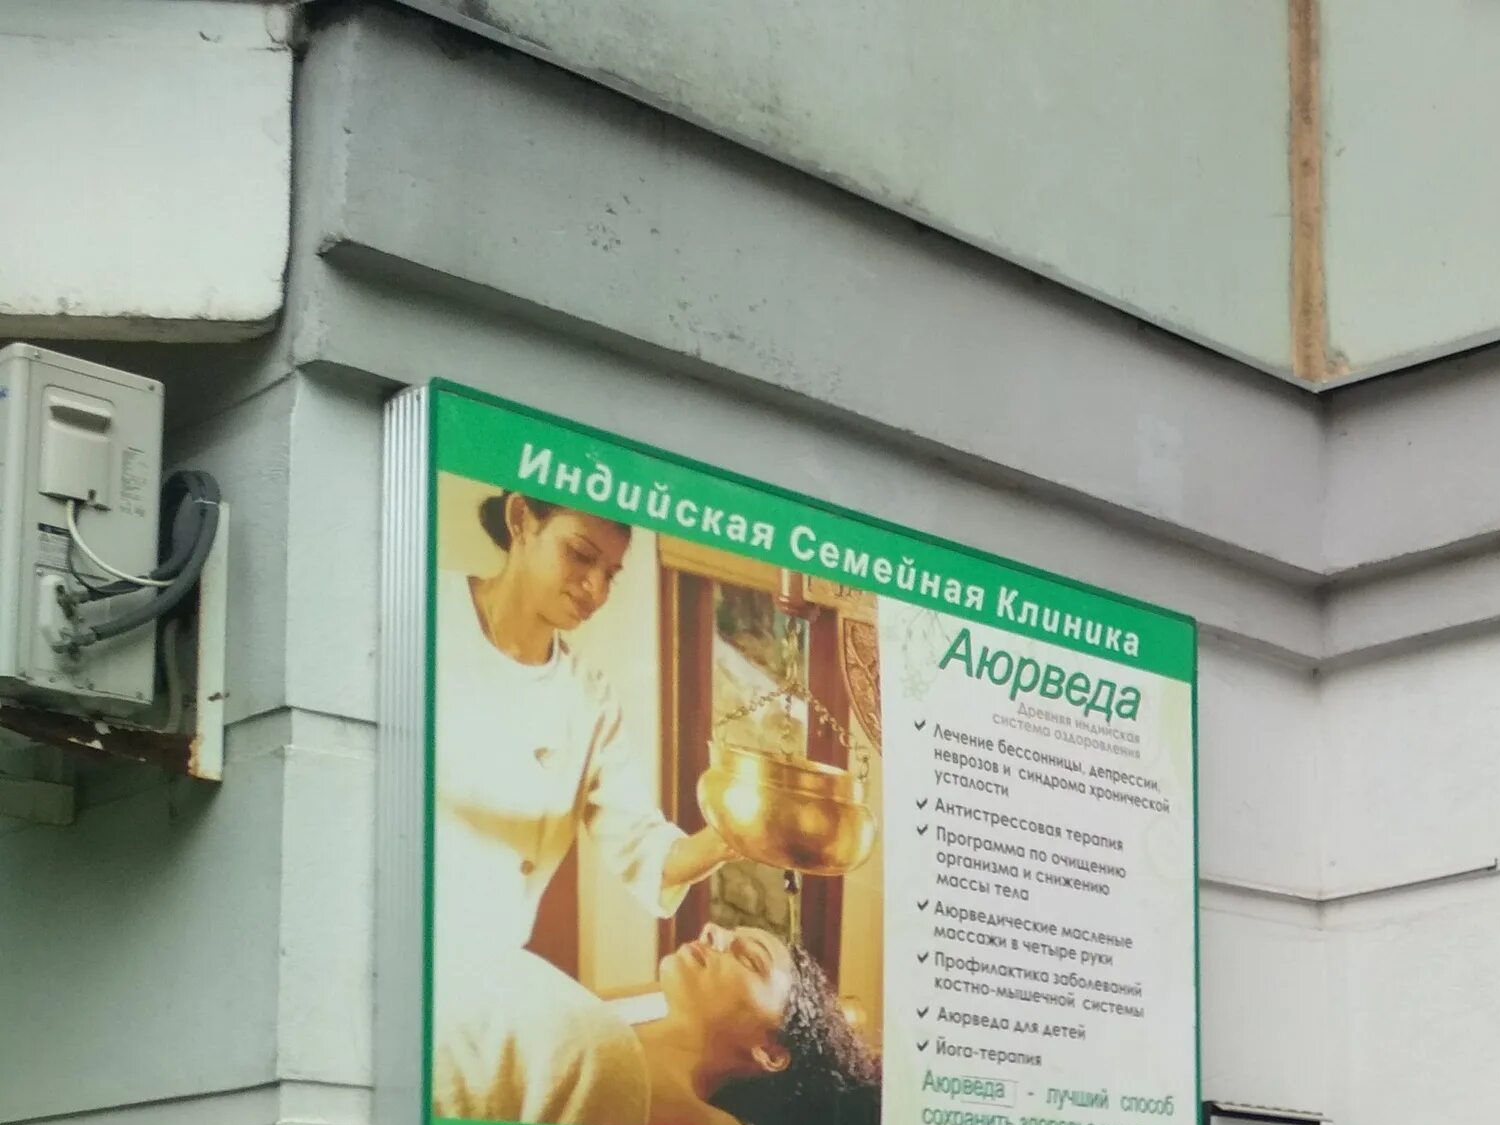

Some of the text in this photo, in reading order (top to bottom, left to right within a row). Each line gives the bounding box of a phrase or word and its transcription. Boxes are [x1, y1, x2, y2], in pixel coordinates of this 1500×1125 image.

[518, 441, 1141, 657] Индийская Семейная Клиника
[938, 627, 1142, 723] Аюрведа
[992, 713, 1051, 737] система
[1017, 702, 1072, 726] Древняя
[934, 724, 994, 751] Лечение
[934, 748, 1170, 814] неврозов и синдрома хронической
[934, 769, 1009, 798] усталости
[934, 799, 1124, 852] Антистрессовая терапия
[937, 826, 1127, 879] Программа по очищению
[937, 850, 1110, 897] организма и снижению
[937, 874, 1029, 901] массы тела
[934, 901, 1133, 949] Аюрведические масленые
[934, 925, 1113, 966] массажи в четыре руки
[934, 951, 1142, 997] Профилактика заболеваний
[934, 976, 1144, 1018] костно-мышечной системы
[937, 1006, 1086, 1041] Аюрведа для детей
[936, 1036, 1042, 1066] Йога-терапия
[922, 1069, 1005, 1100] Аюрведа
[1046, 1085, 1109, 1110] лучший
[1120, 1095, 1174, 1116] способ
